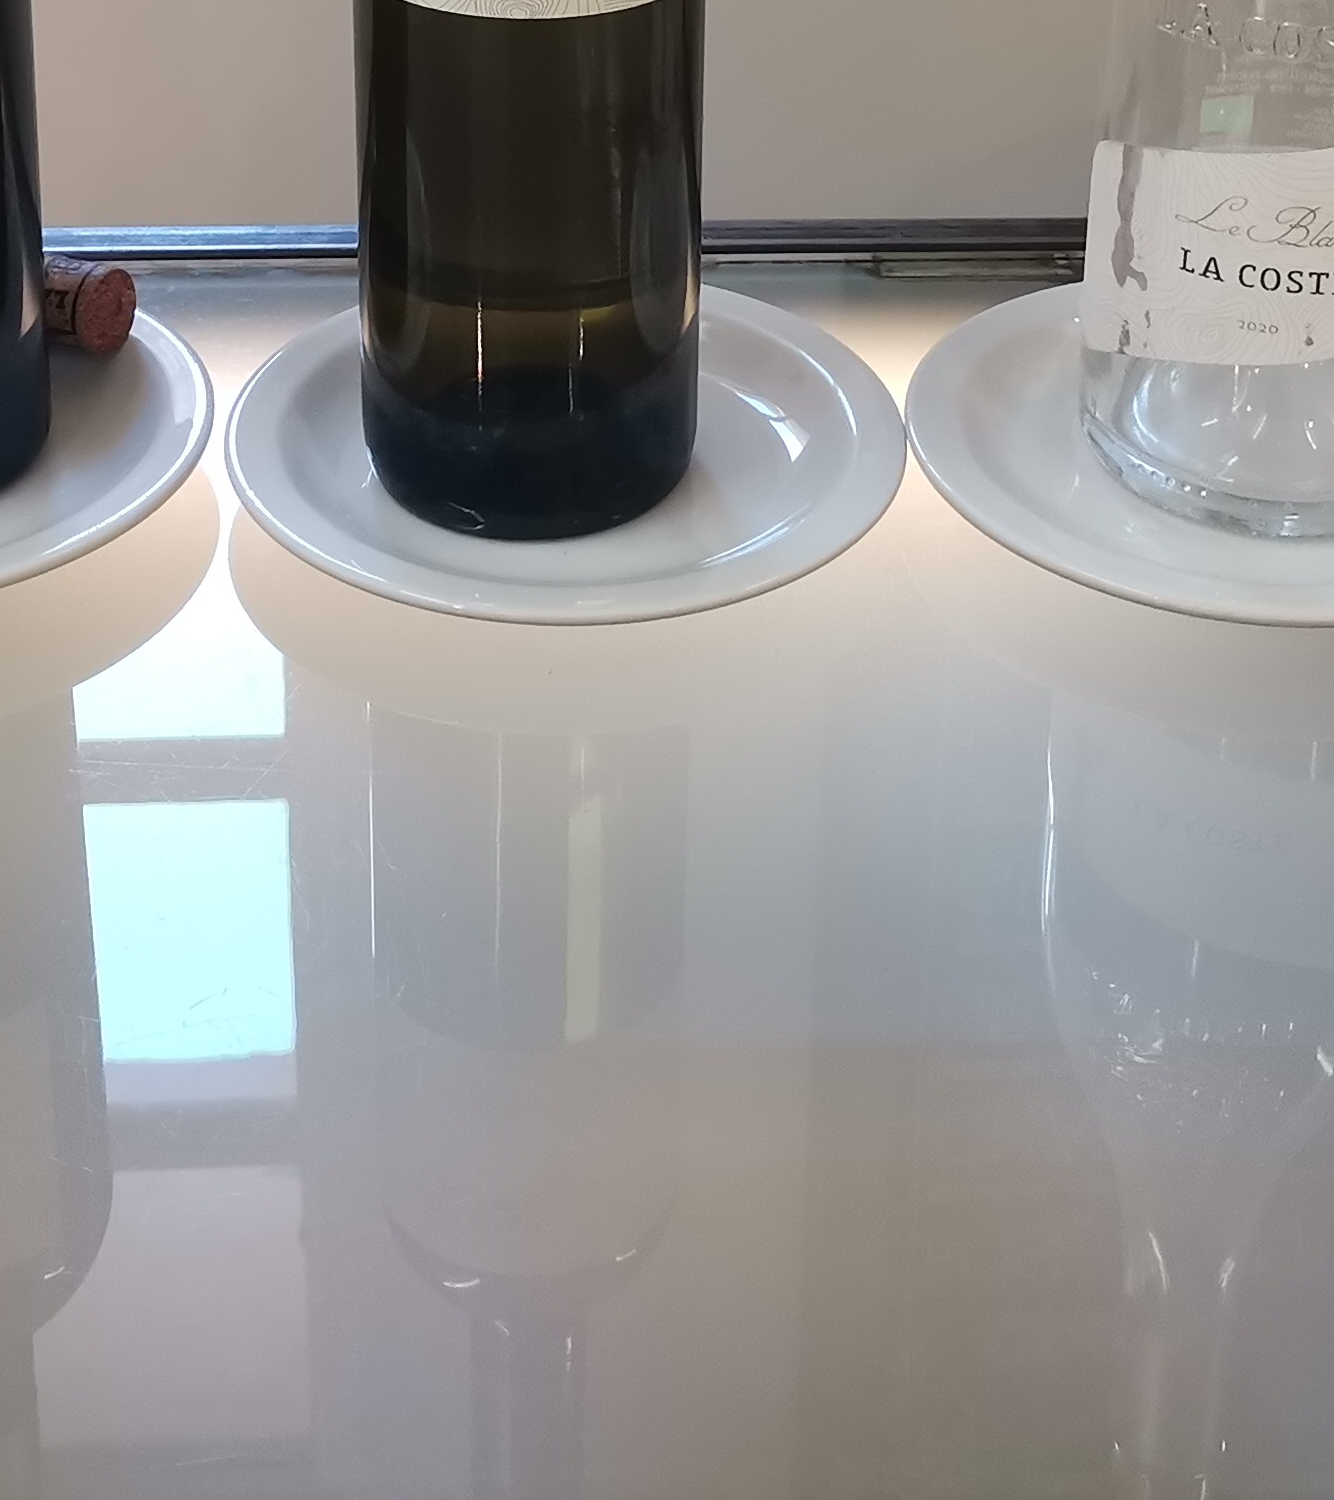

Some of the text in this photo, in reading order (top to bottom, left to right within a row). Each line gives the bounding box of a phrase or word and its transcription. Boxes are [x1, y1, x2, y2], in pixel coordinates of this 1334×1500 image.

[1174, 195, 1249, 237] Le
[1178, 246, 1225, 283] LA
[1236, 319, 1280, 335] 2020
